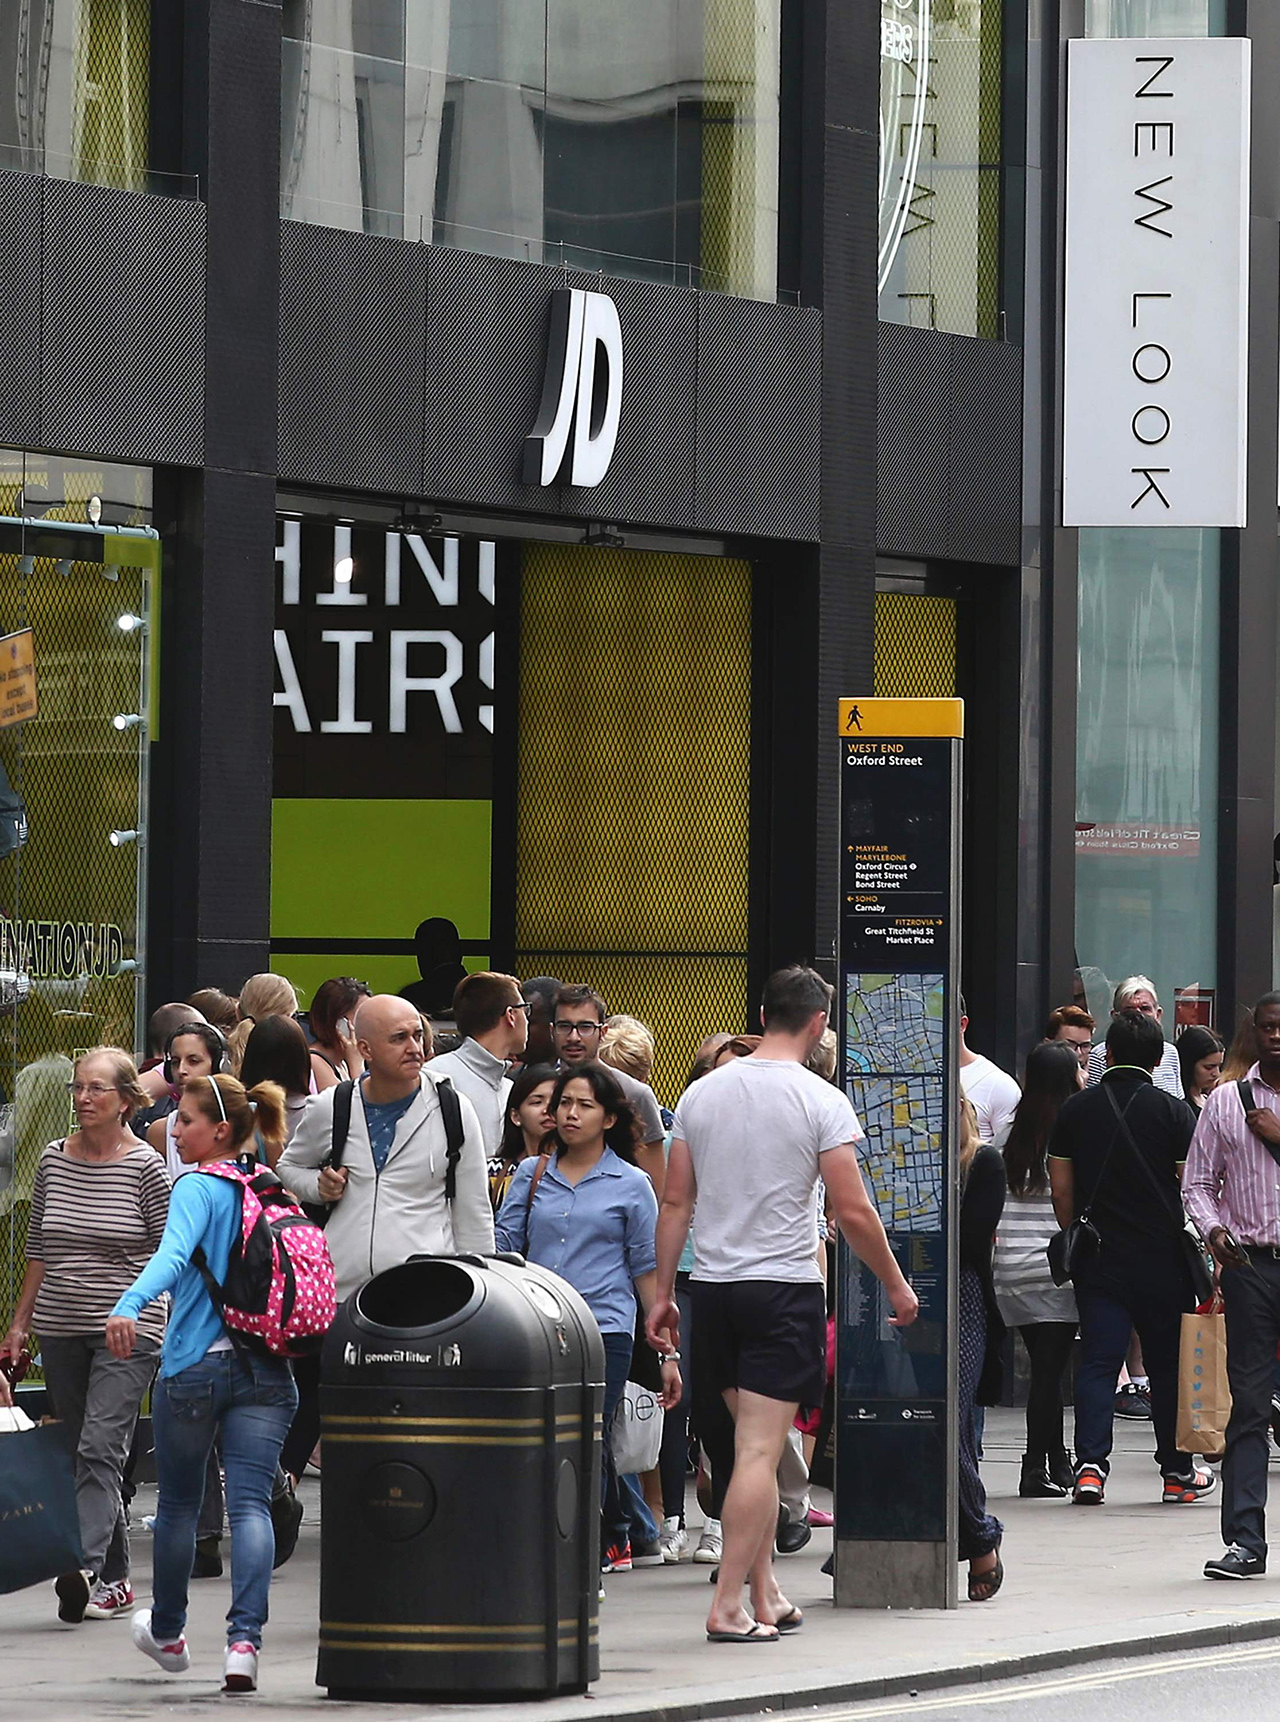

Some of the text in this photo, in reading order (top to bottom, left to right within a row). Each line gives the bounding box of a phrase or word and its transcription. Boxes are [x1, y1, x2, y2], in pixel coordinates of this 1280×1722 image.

[1130, 56, 1174, 509] NEW LOOK
[525, 287, 624, 488] JD
[847, 743, 904, 753] WEST END
[847, 755, 923, 766] Oxford Street
[855, 862, 908, 870] Oxford Circus
[855, 871, 908, 880] Regent Street
[855, 880, 901, 889] Bond Street
[855, 895, 878, 903] SOHO
[855, 903, 886, 913] Carnaby
[864, 927, 935, 936] Great Titchfield St
[886, 936, 935, 944] Market Place
[365, 1350, 432, 1365] general litter
[613, 1394, 658, 1422] ne
